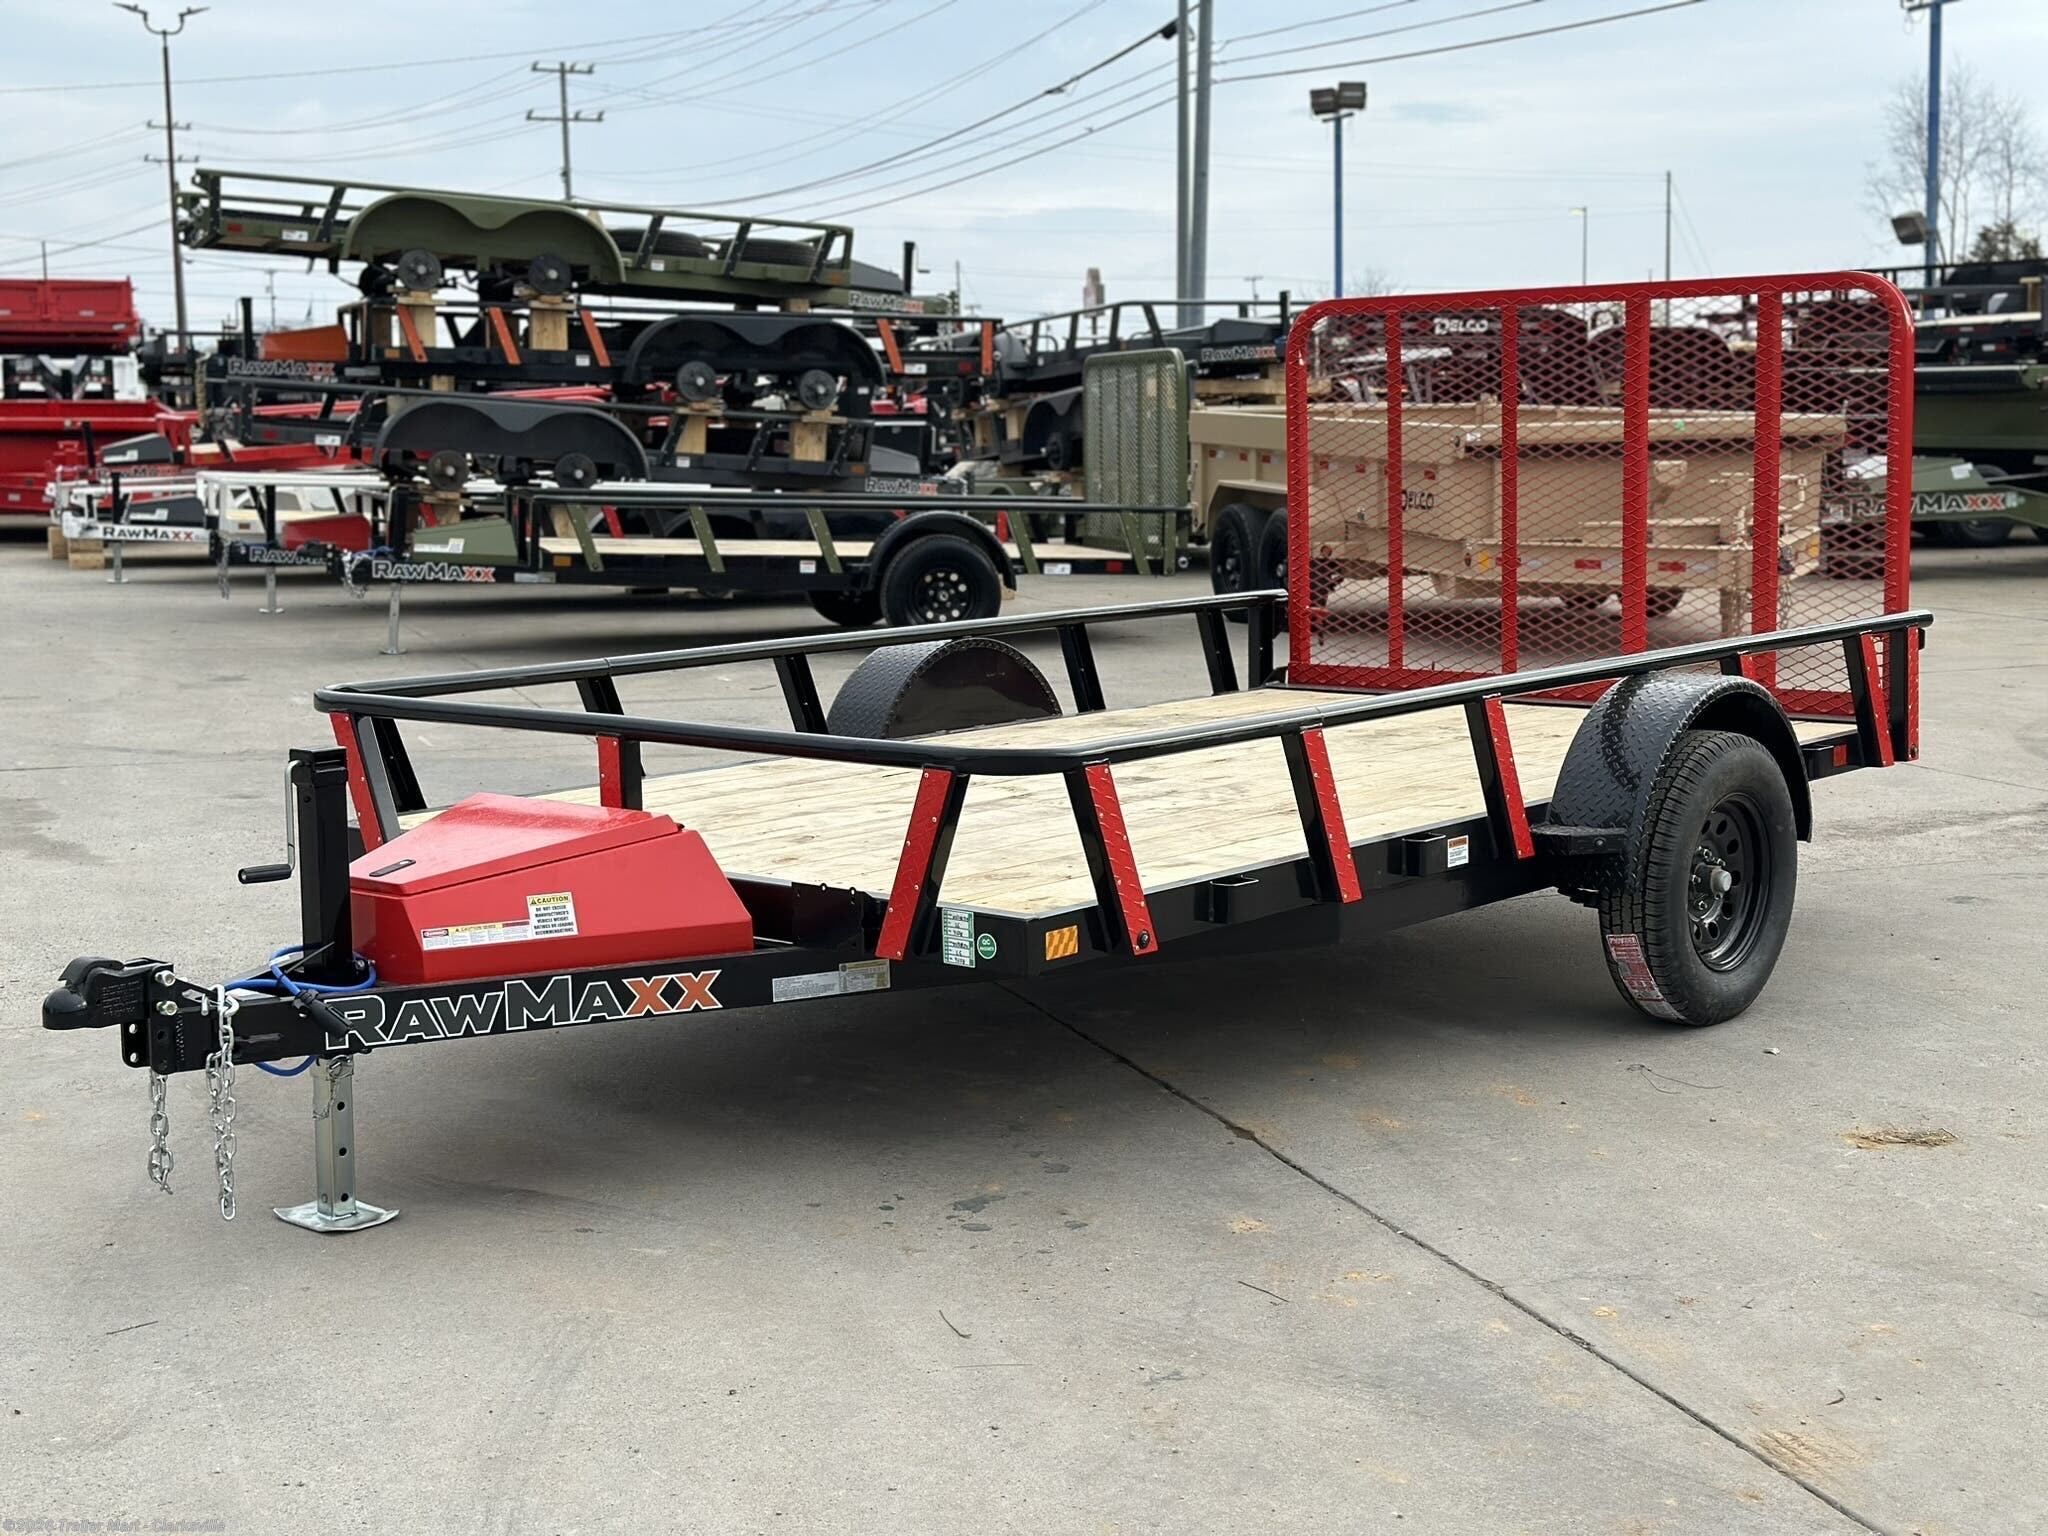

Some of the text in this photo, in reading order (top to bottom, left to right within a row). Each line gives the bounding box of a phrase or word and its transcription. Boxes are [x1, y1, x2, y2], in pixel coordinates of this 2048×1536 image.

[1433, 317, 1489, 335] DELCO
[372, 560, 496, 583] RAWMAXX
[537, 896, 569, 904] CAUTION
[325, 969, 723, 1051] RAWMAXX
